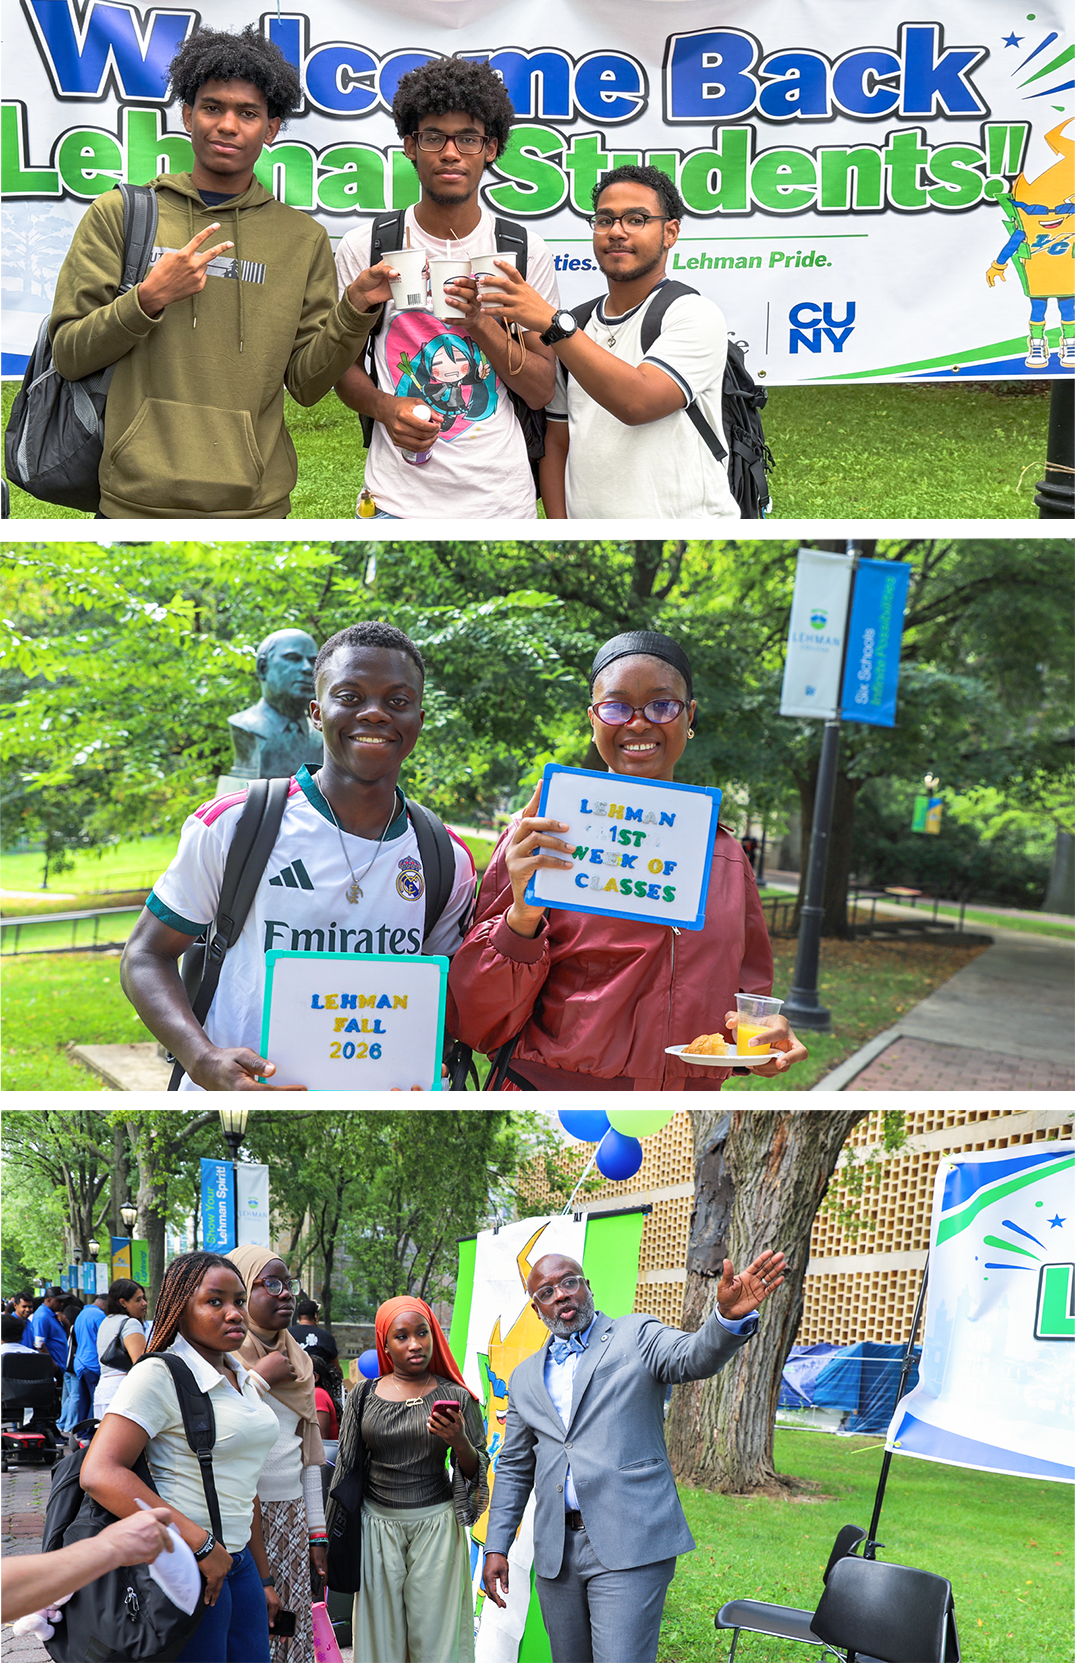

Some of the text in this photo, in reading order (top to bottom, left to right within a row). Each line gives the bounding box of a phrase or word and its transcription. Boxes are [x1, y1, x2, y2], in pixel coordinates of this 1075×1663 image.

[20, 0, 990, 127] Wlcme Back
[672, 253, 762, 270] Lehman
[768, 250, 833, 268] Pride.
[788, 301, 856, 330] CU
[788, 326, 856, 354] NY
[857, 627, 876, 682] Schools
[854, 683, 870, 705] Six
[580, 798, 677, 828] LEHMAN
[609, 825, 647, 848] 1ST
[647, 857, 678, 876] OF
[574, 872, 677, 903] CLASSES
[264, 919, 421, 955] Emirates
[311, 993, 409, 1010] LEHMAN
[333, 1017, 387, 1035] FALL
[329, 1041, 383, 1060] 2026
[204, 1185, 217, 1245] Show Your
[215, 1165, 229, 1246] Lehman Spirit!
[238, 1209, 268, 1219] LEHMAN
